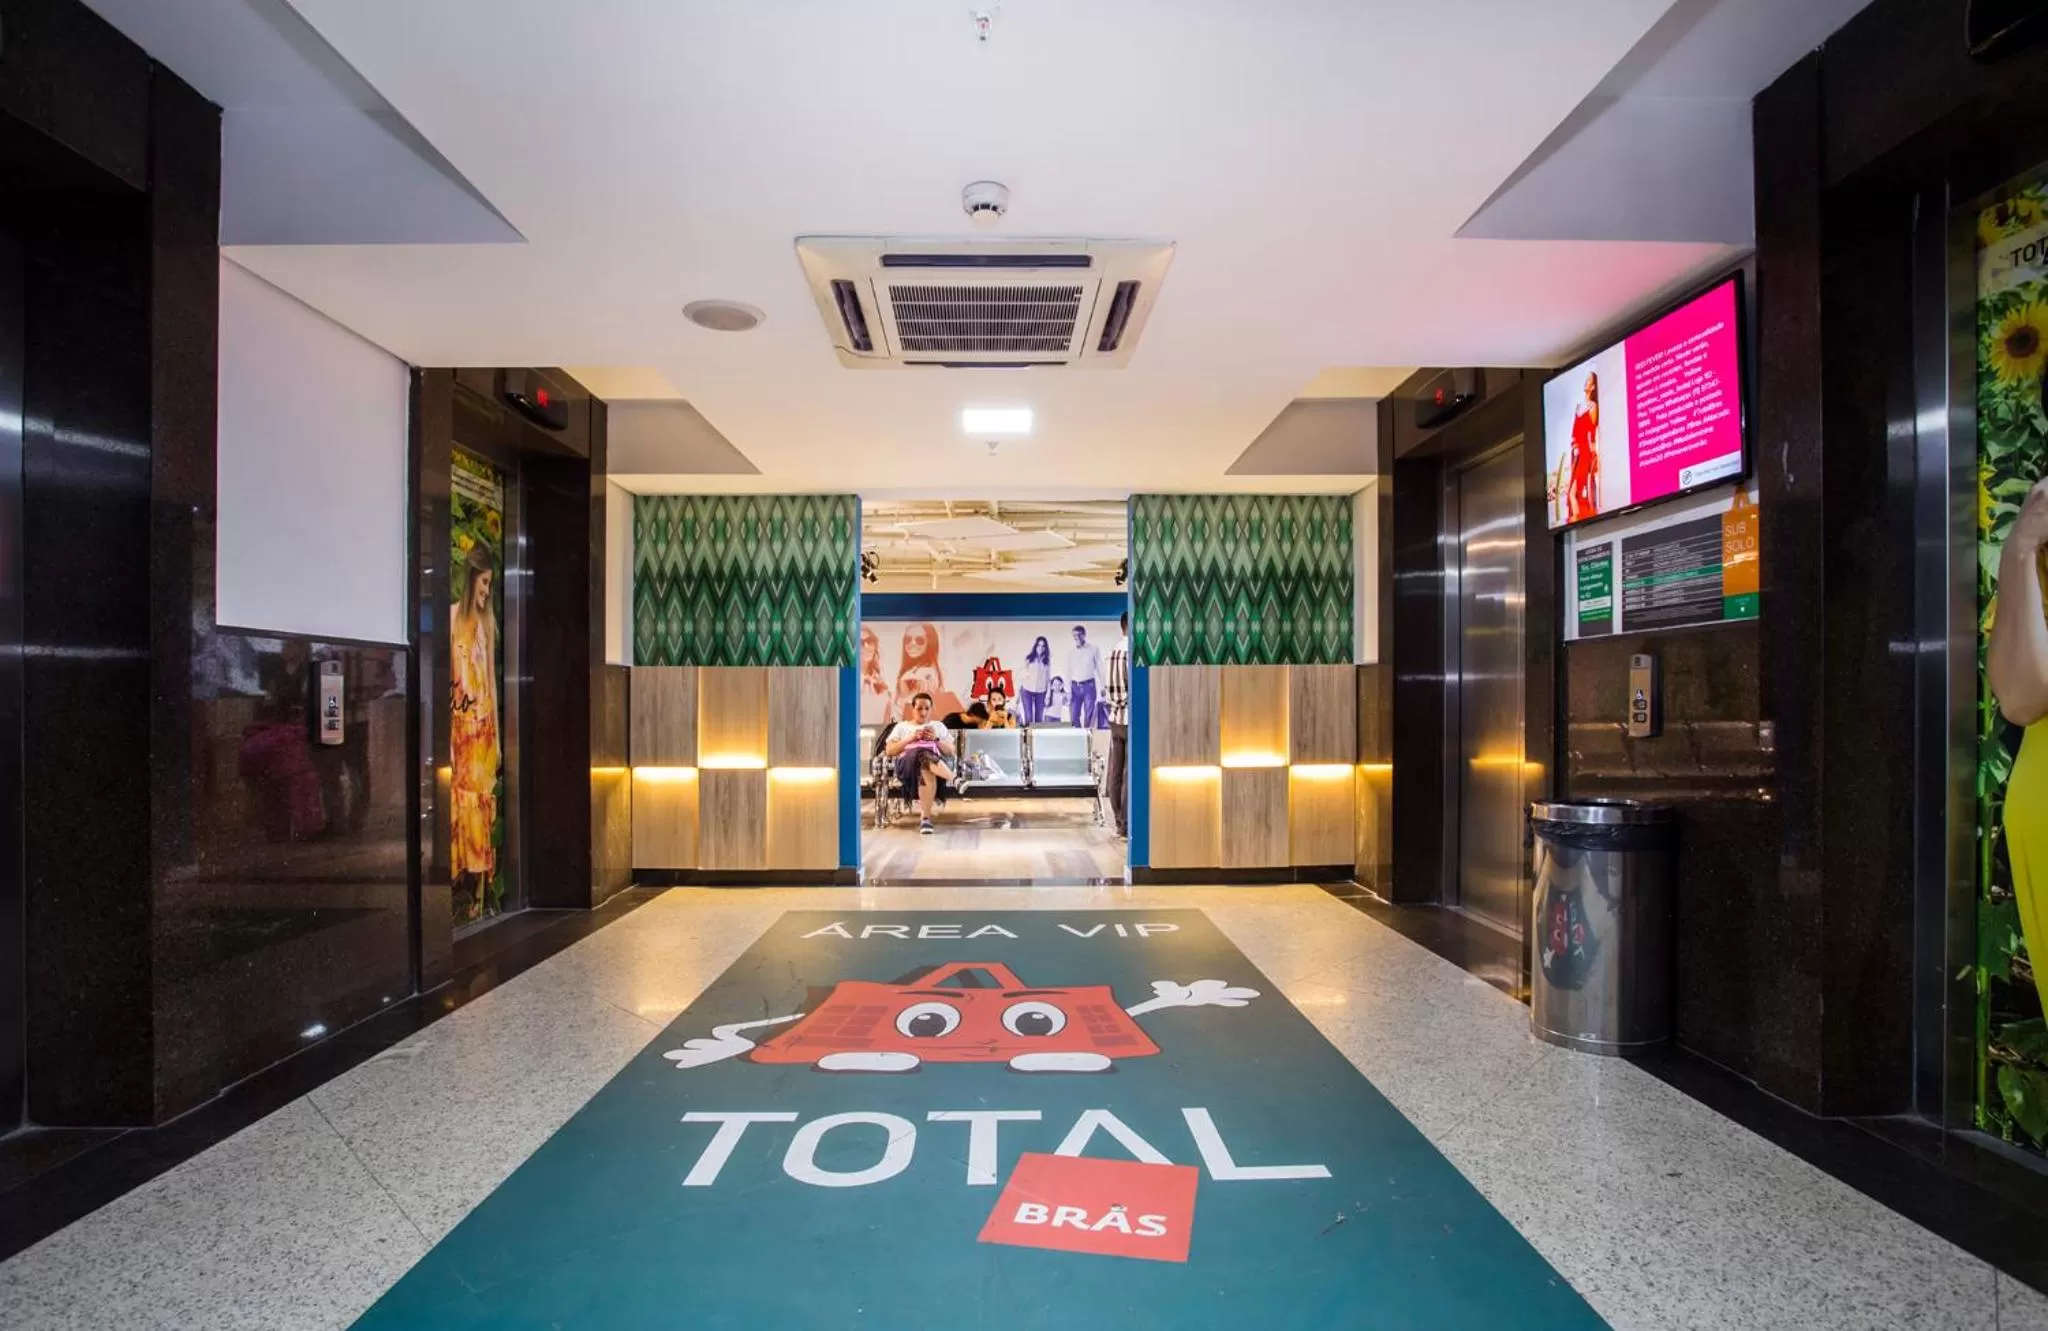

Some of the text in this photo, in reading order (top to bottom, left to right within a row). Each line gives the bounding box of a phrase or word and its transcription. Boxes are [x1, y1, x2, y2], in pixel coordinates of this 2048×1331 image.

[1725, 521, 1746, 537] SUB
[1726, 536, 1754, 553] SOLO
[800, 921, 1180, 939] ÁREA VIP
[680, 1107, 1333, 1187] TOTAL
